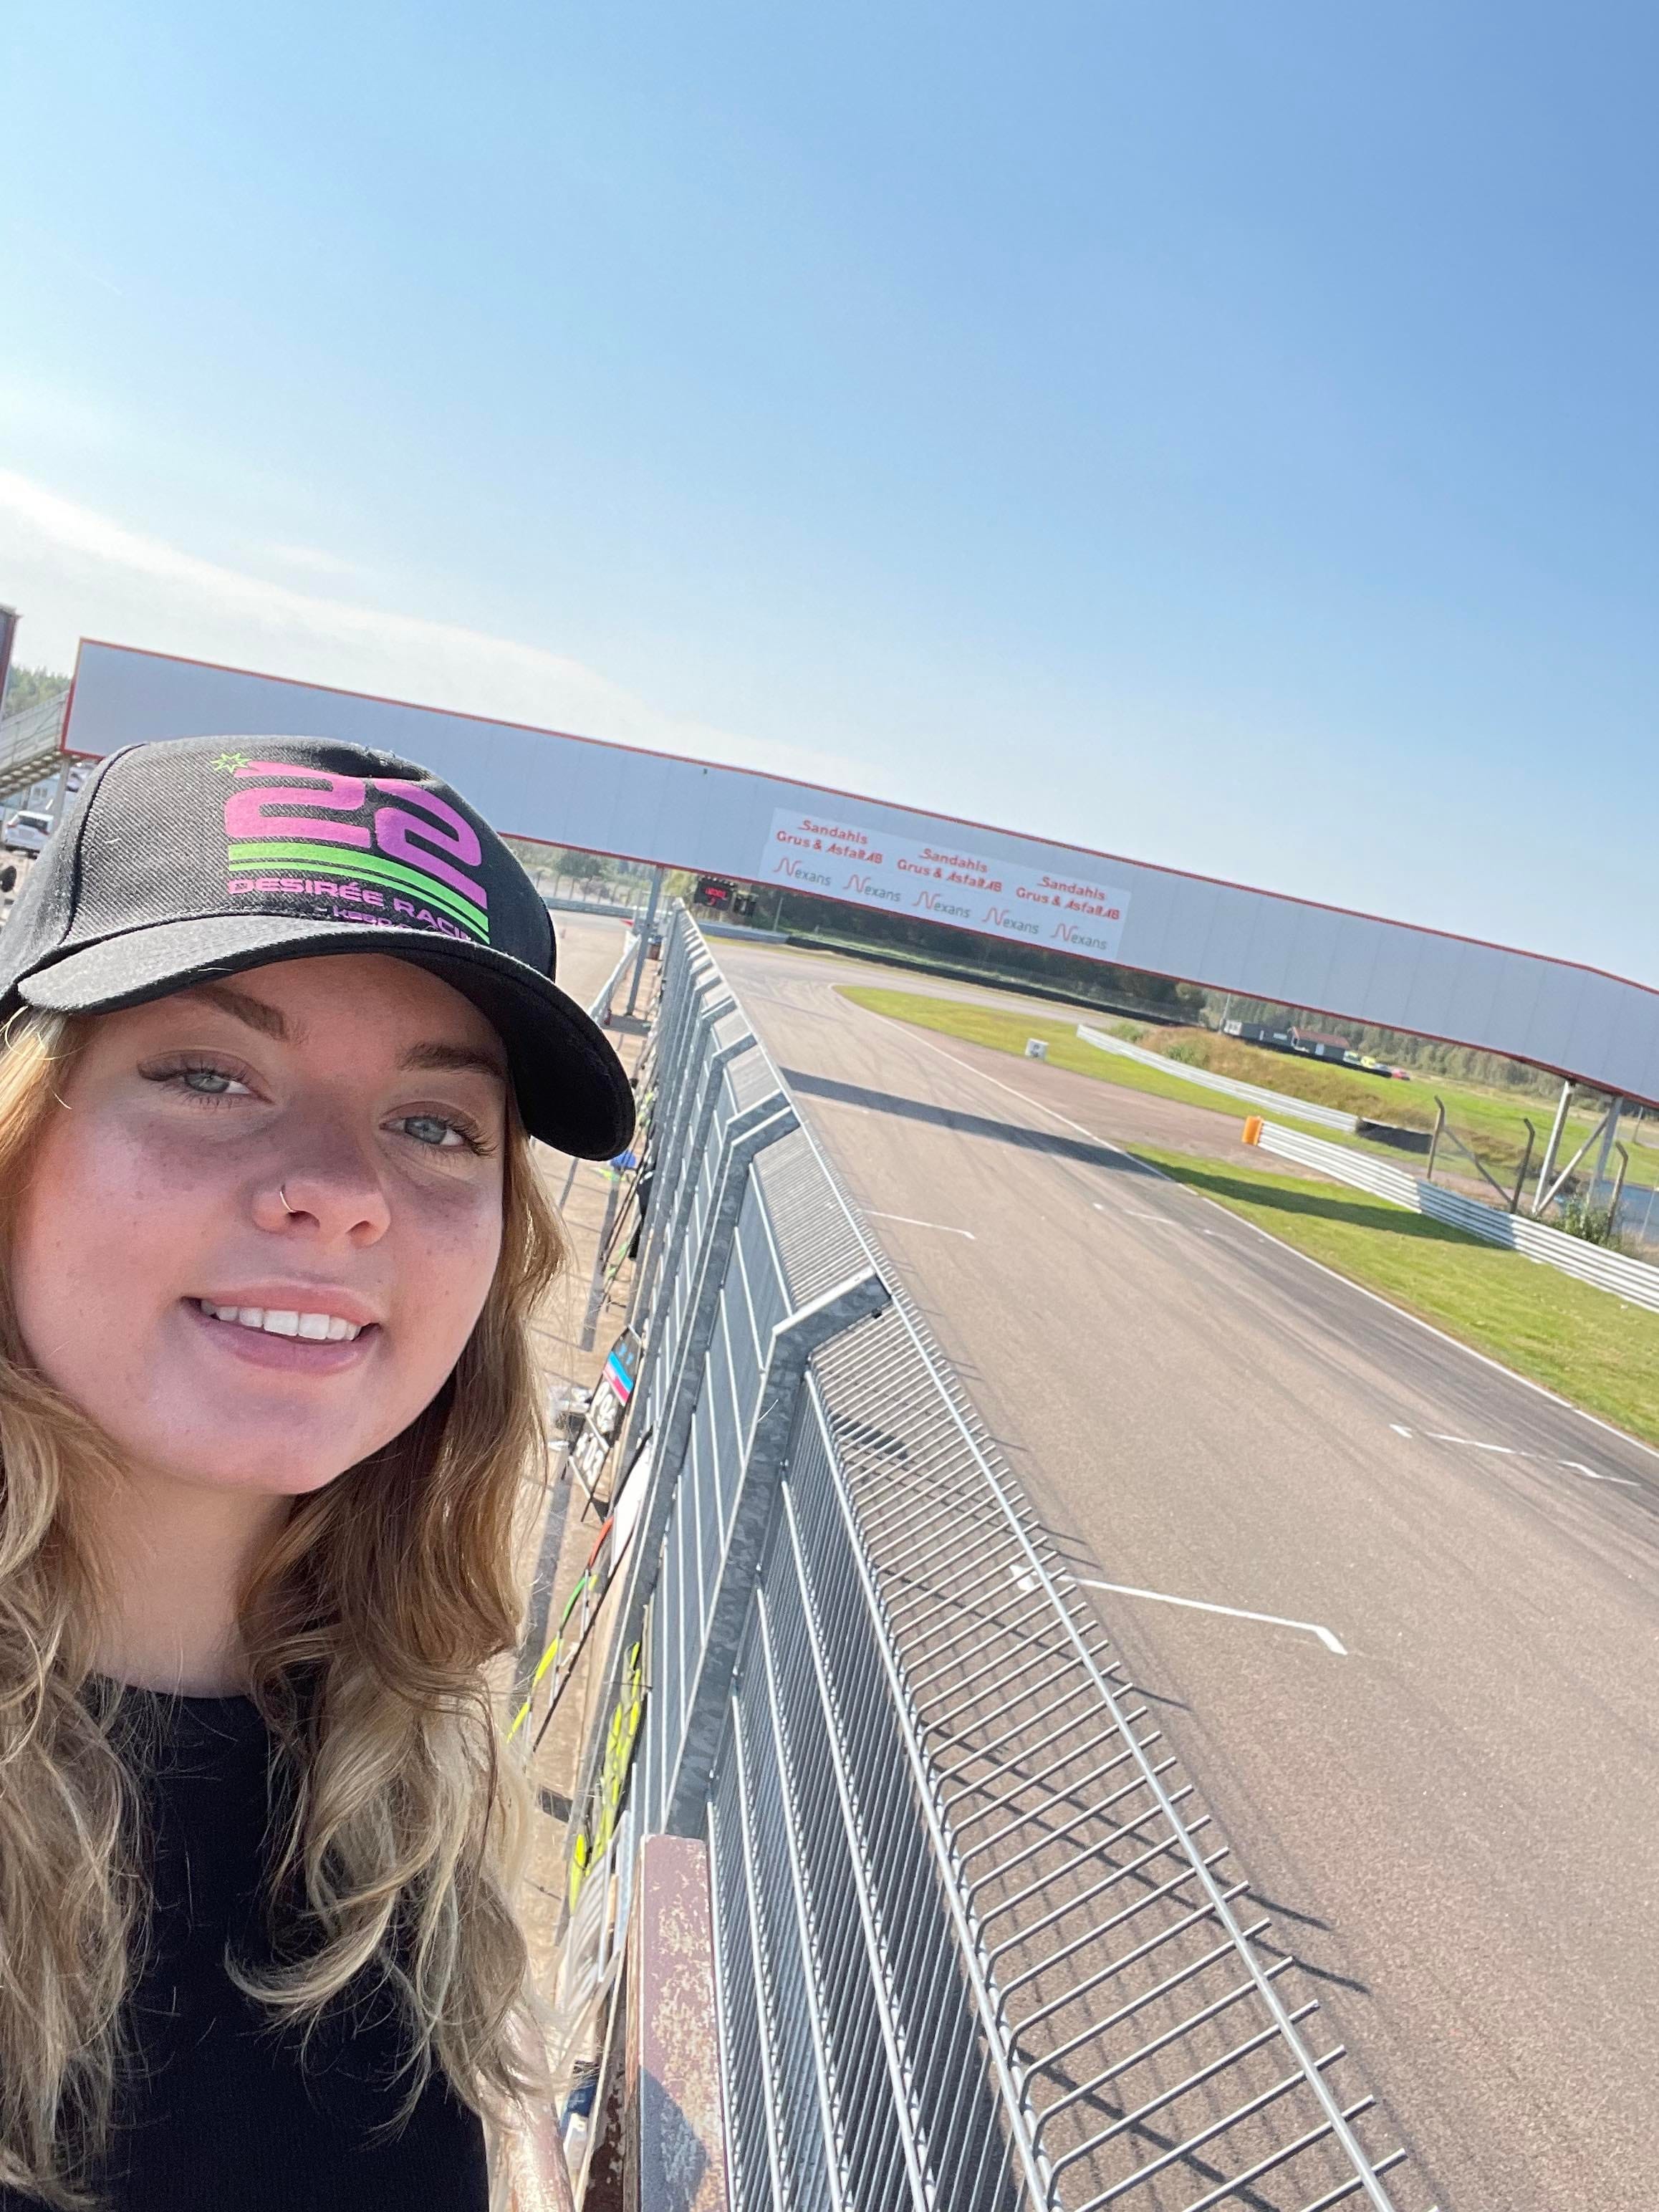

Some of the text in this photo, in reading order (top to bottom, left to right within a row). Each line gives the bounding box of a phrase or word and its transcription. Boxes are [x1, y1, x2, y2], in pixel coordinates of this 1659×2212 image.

[224, 761, 489, 910] 22
[776, 830, 810, 847] Grus
[813, 840, 822, 850] &
[797, 819, 867, 845] Sandahls
[774, 857, 831, 886] Nexans
[898, 859, 930, 875] Grus
[933, 867, 942, 878] &
[919, 848, 988, 872] Sandahls
[228, 877, 385, 907] DESIRÉE
[842, 874, 901, 902] Nexans
[1016, 887, 1049, 903] Grus
[1052, 895, 1060, 907] &
[1037, 876, 1106, 900] Sandahls
[912, 891, 971, 918] Nexans
[981, 906, 1039, 934] Nexans
[1050, 923, 1107, 950] Nexans
